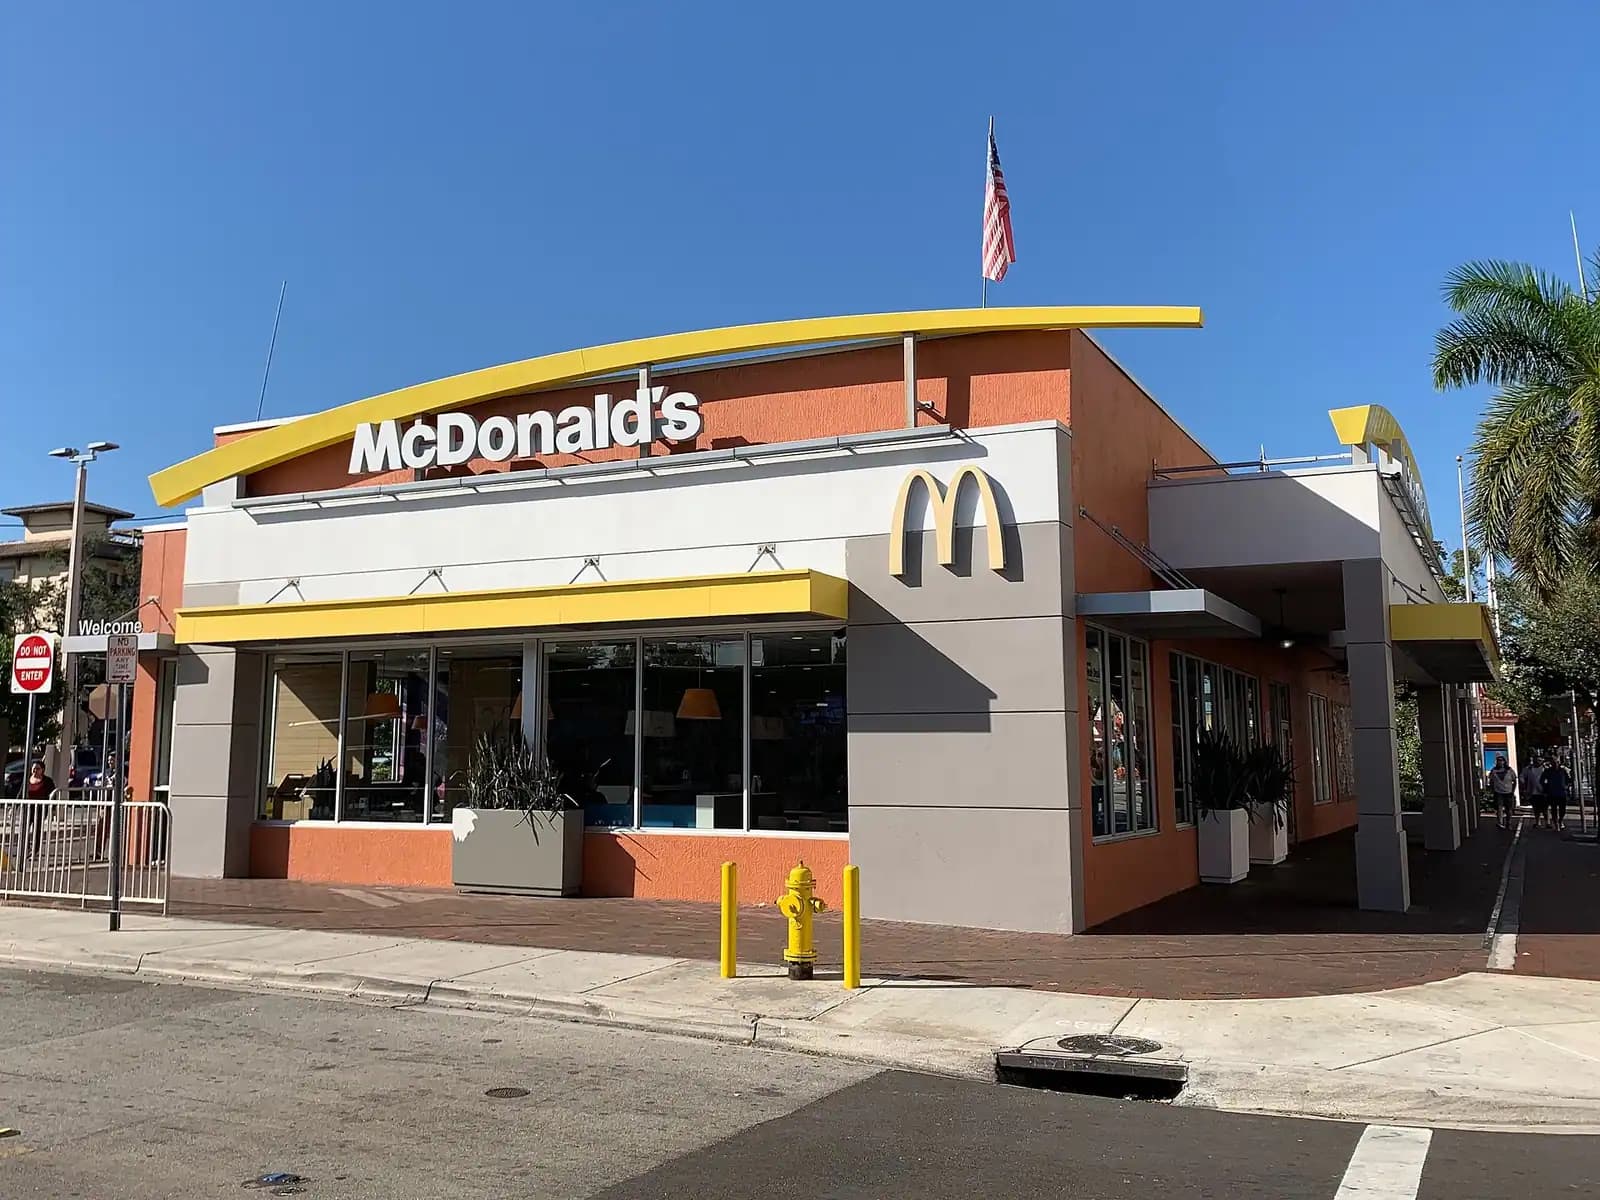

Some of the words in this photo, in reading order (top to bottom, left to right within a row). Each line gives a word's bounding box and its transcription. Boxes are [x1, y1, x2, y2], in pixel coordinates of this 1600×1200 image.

[348, 386, 703, 475] McDonald's
[78, 618, 143, 636] Welcome
[117, 637, 130, 646] NO
[20, 646, 31, 657] DO
[33, 645, 47, 656] NOT
[110, 647, 136, 657] PARKING
[21, 670, 43, 681] ENTER
